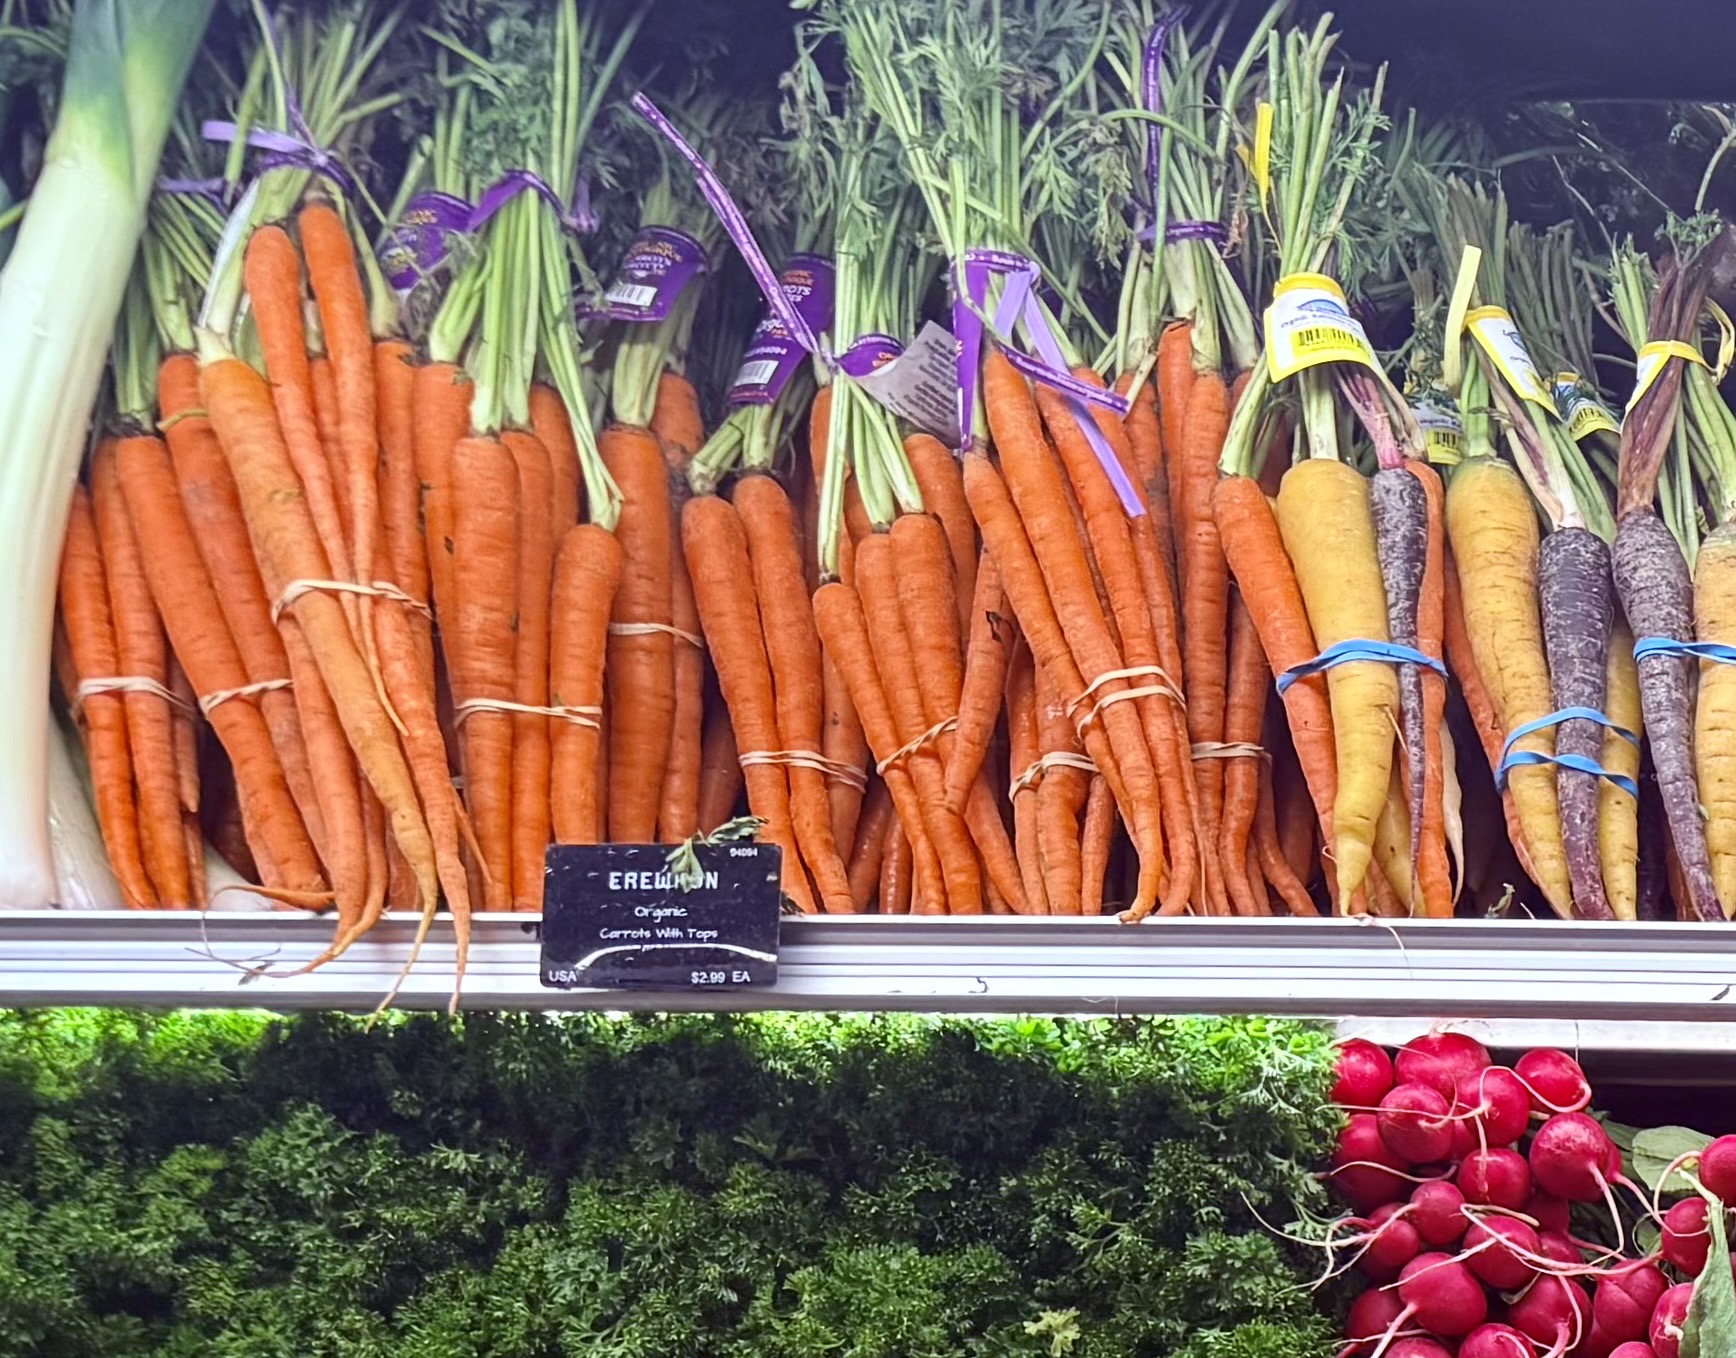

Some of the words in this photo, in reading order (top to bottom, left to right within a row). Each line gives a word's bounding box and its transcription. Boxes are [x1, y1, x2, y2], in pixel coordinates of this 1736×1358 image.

[635, 907, 688, 922] Organic
[600, 929, 651, 939] Carrots
[656, 928, 683, 938] With
[687, 929, 717, 942] Tops
[549, 972, 576, 982] USA
[691, 972, 725, 983] $2.99
[733, 971, 750, 982] EA
